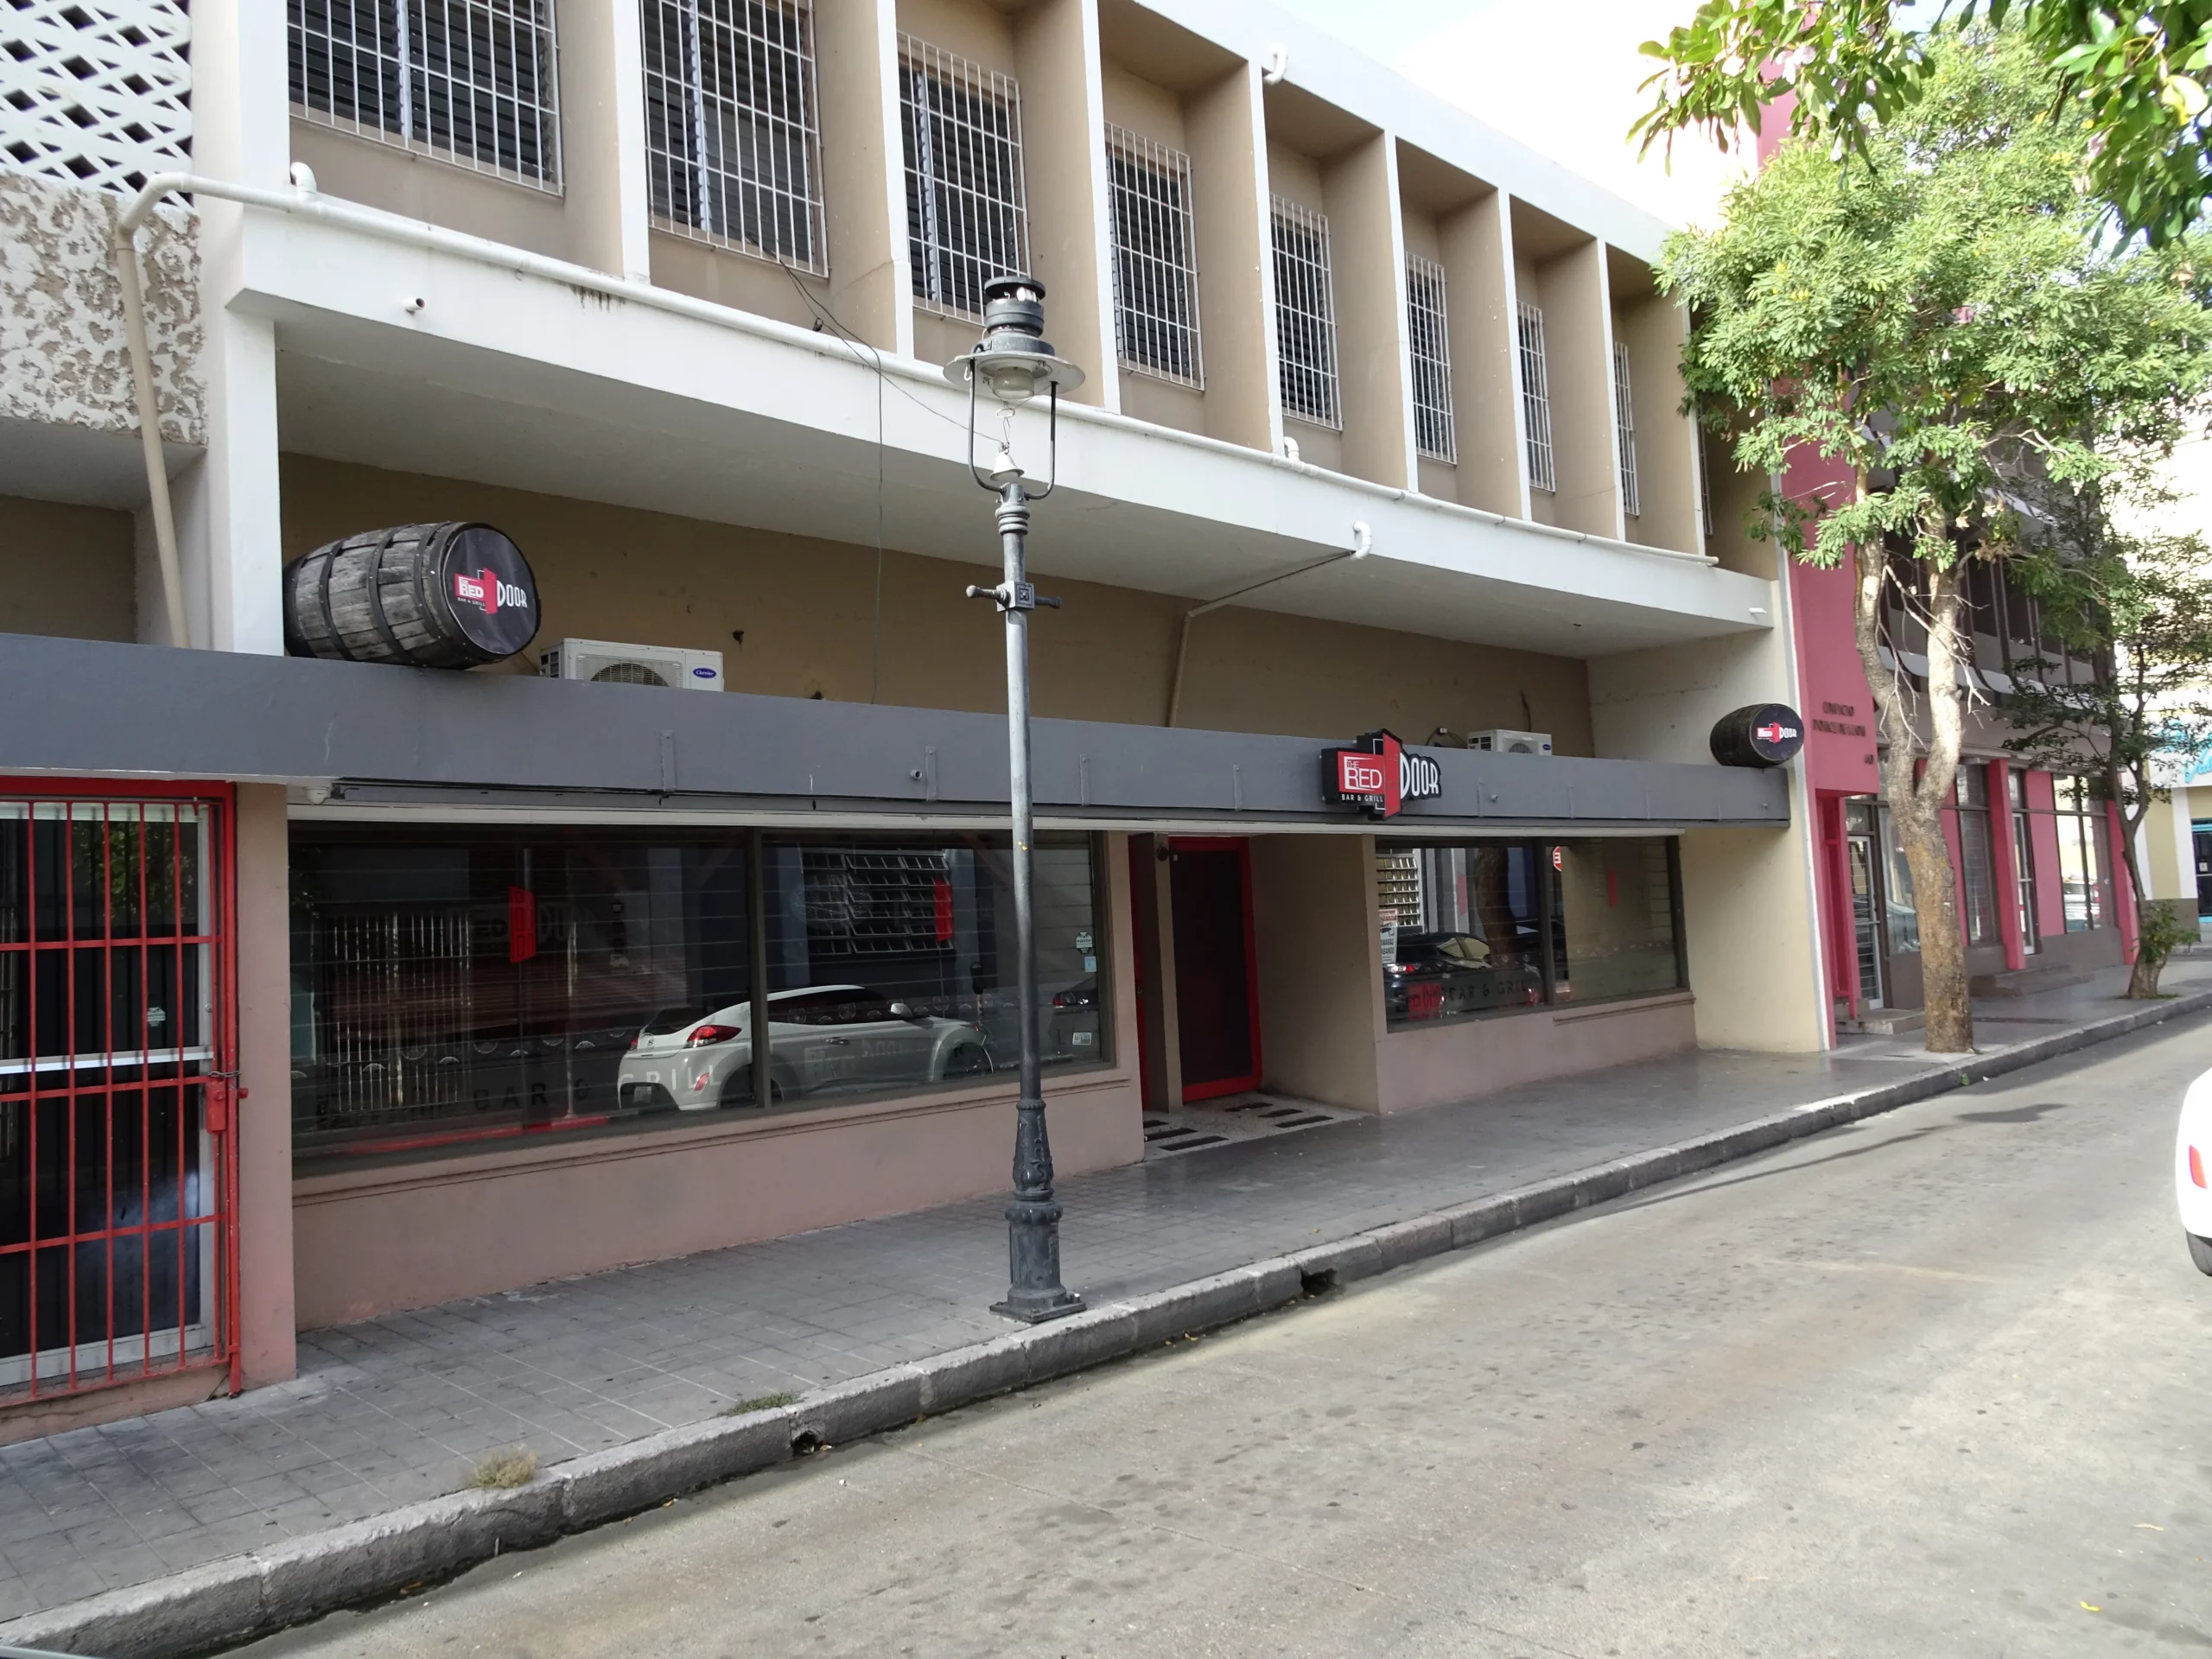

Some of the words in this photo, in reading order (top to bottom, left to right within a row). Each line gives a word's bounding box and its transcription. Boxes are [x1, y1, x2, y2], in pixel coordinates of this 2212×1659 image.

[459, 580, 484, 598] RED
[497, 580, 527, 608] DOOR
[1344, 766, 1382, 789] RED
[1400, 752, 1440, 799] DOOR
[1346, 760, 1359, 768] THE
